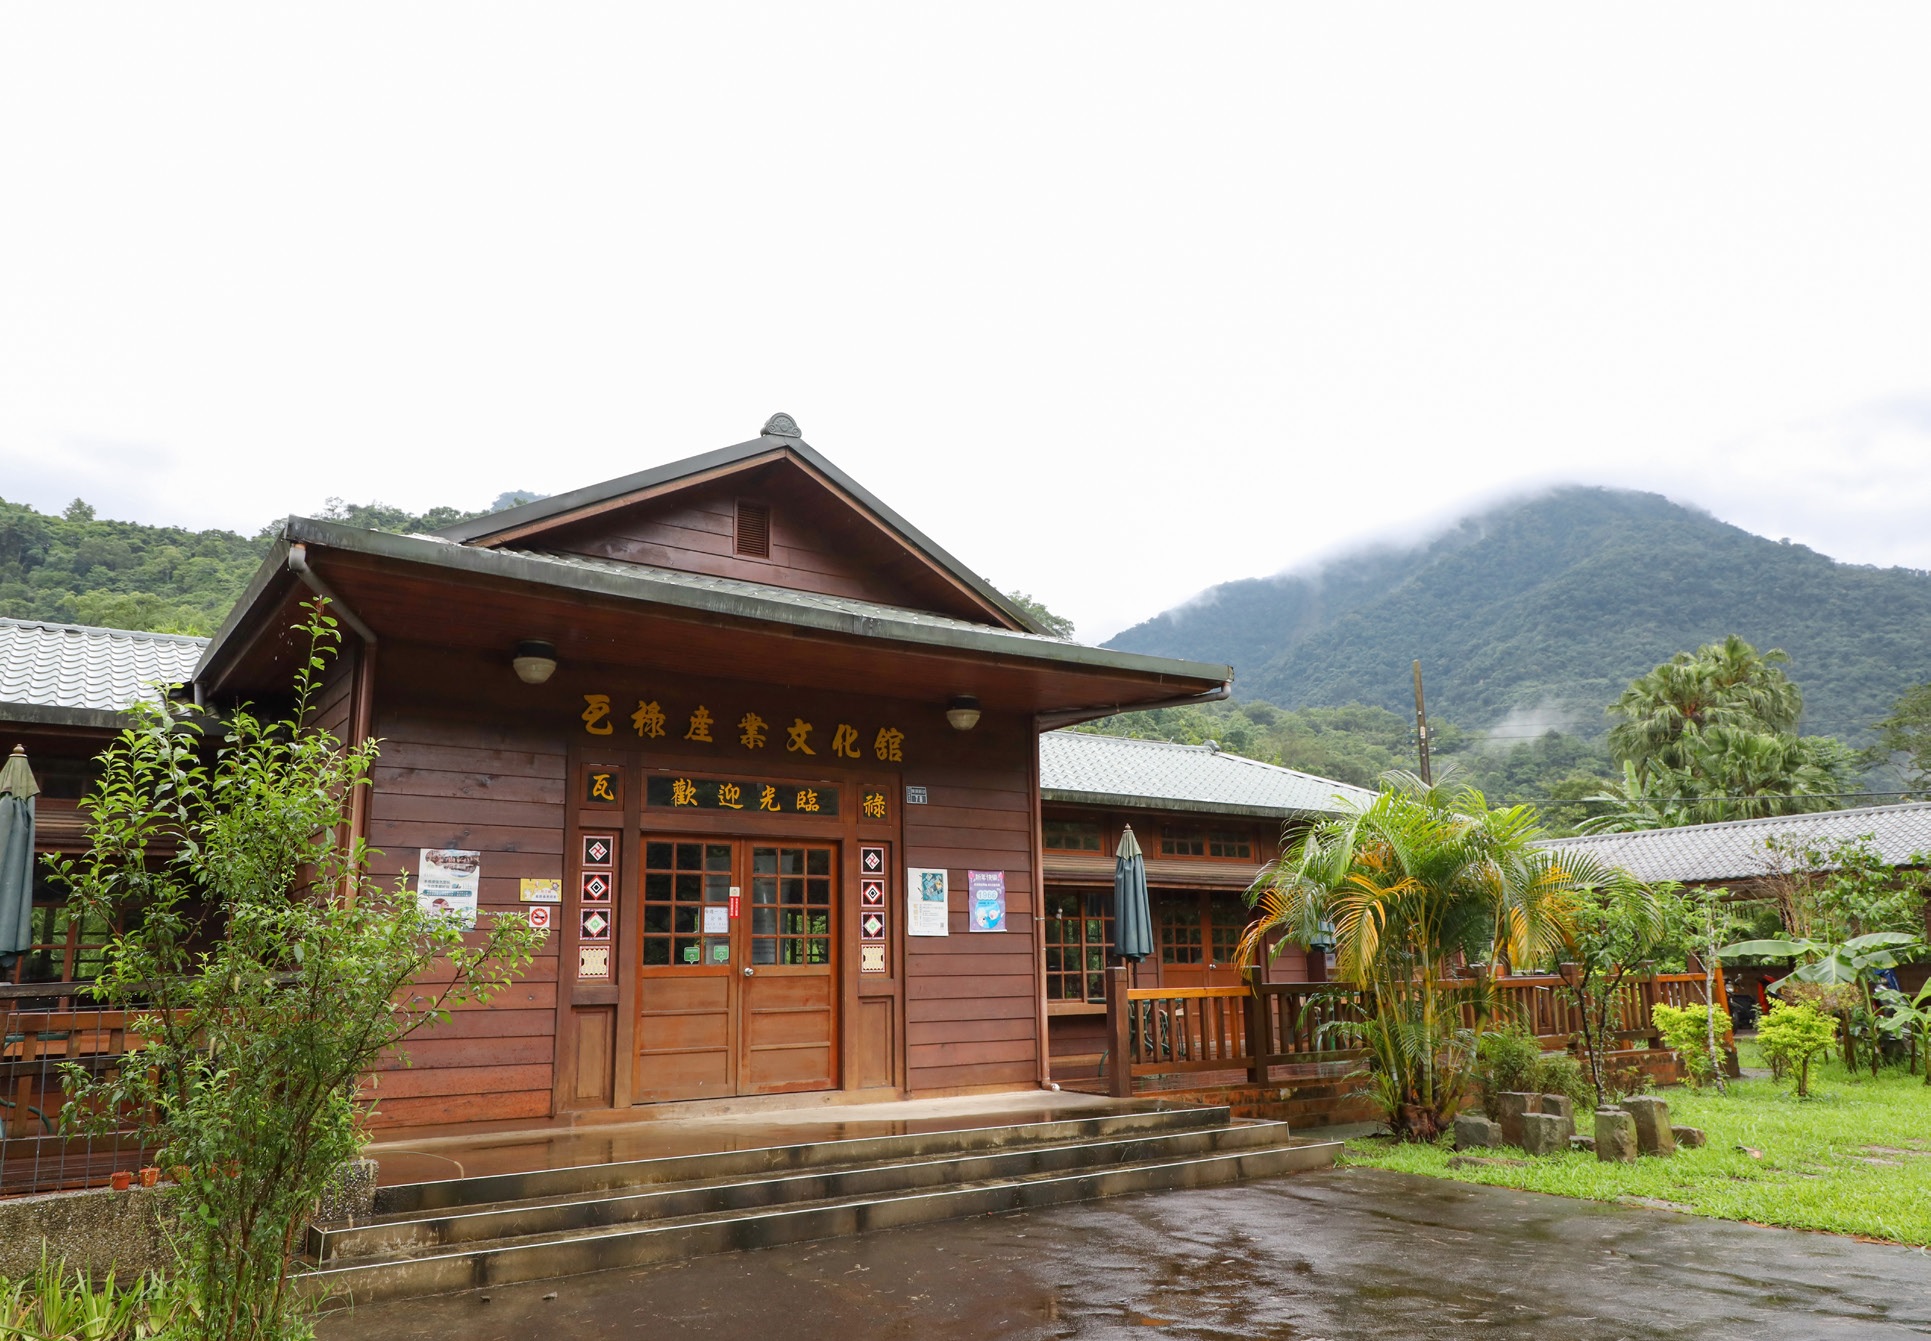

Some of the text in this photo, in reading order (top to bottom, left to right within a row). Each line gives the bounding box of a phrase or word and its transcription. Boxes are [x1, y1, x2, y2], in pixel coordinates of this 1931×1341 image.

[592, 773, 614, 800] 瓦
[671, 778, 820, 812] 歡迎光臨
